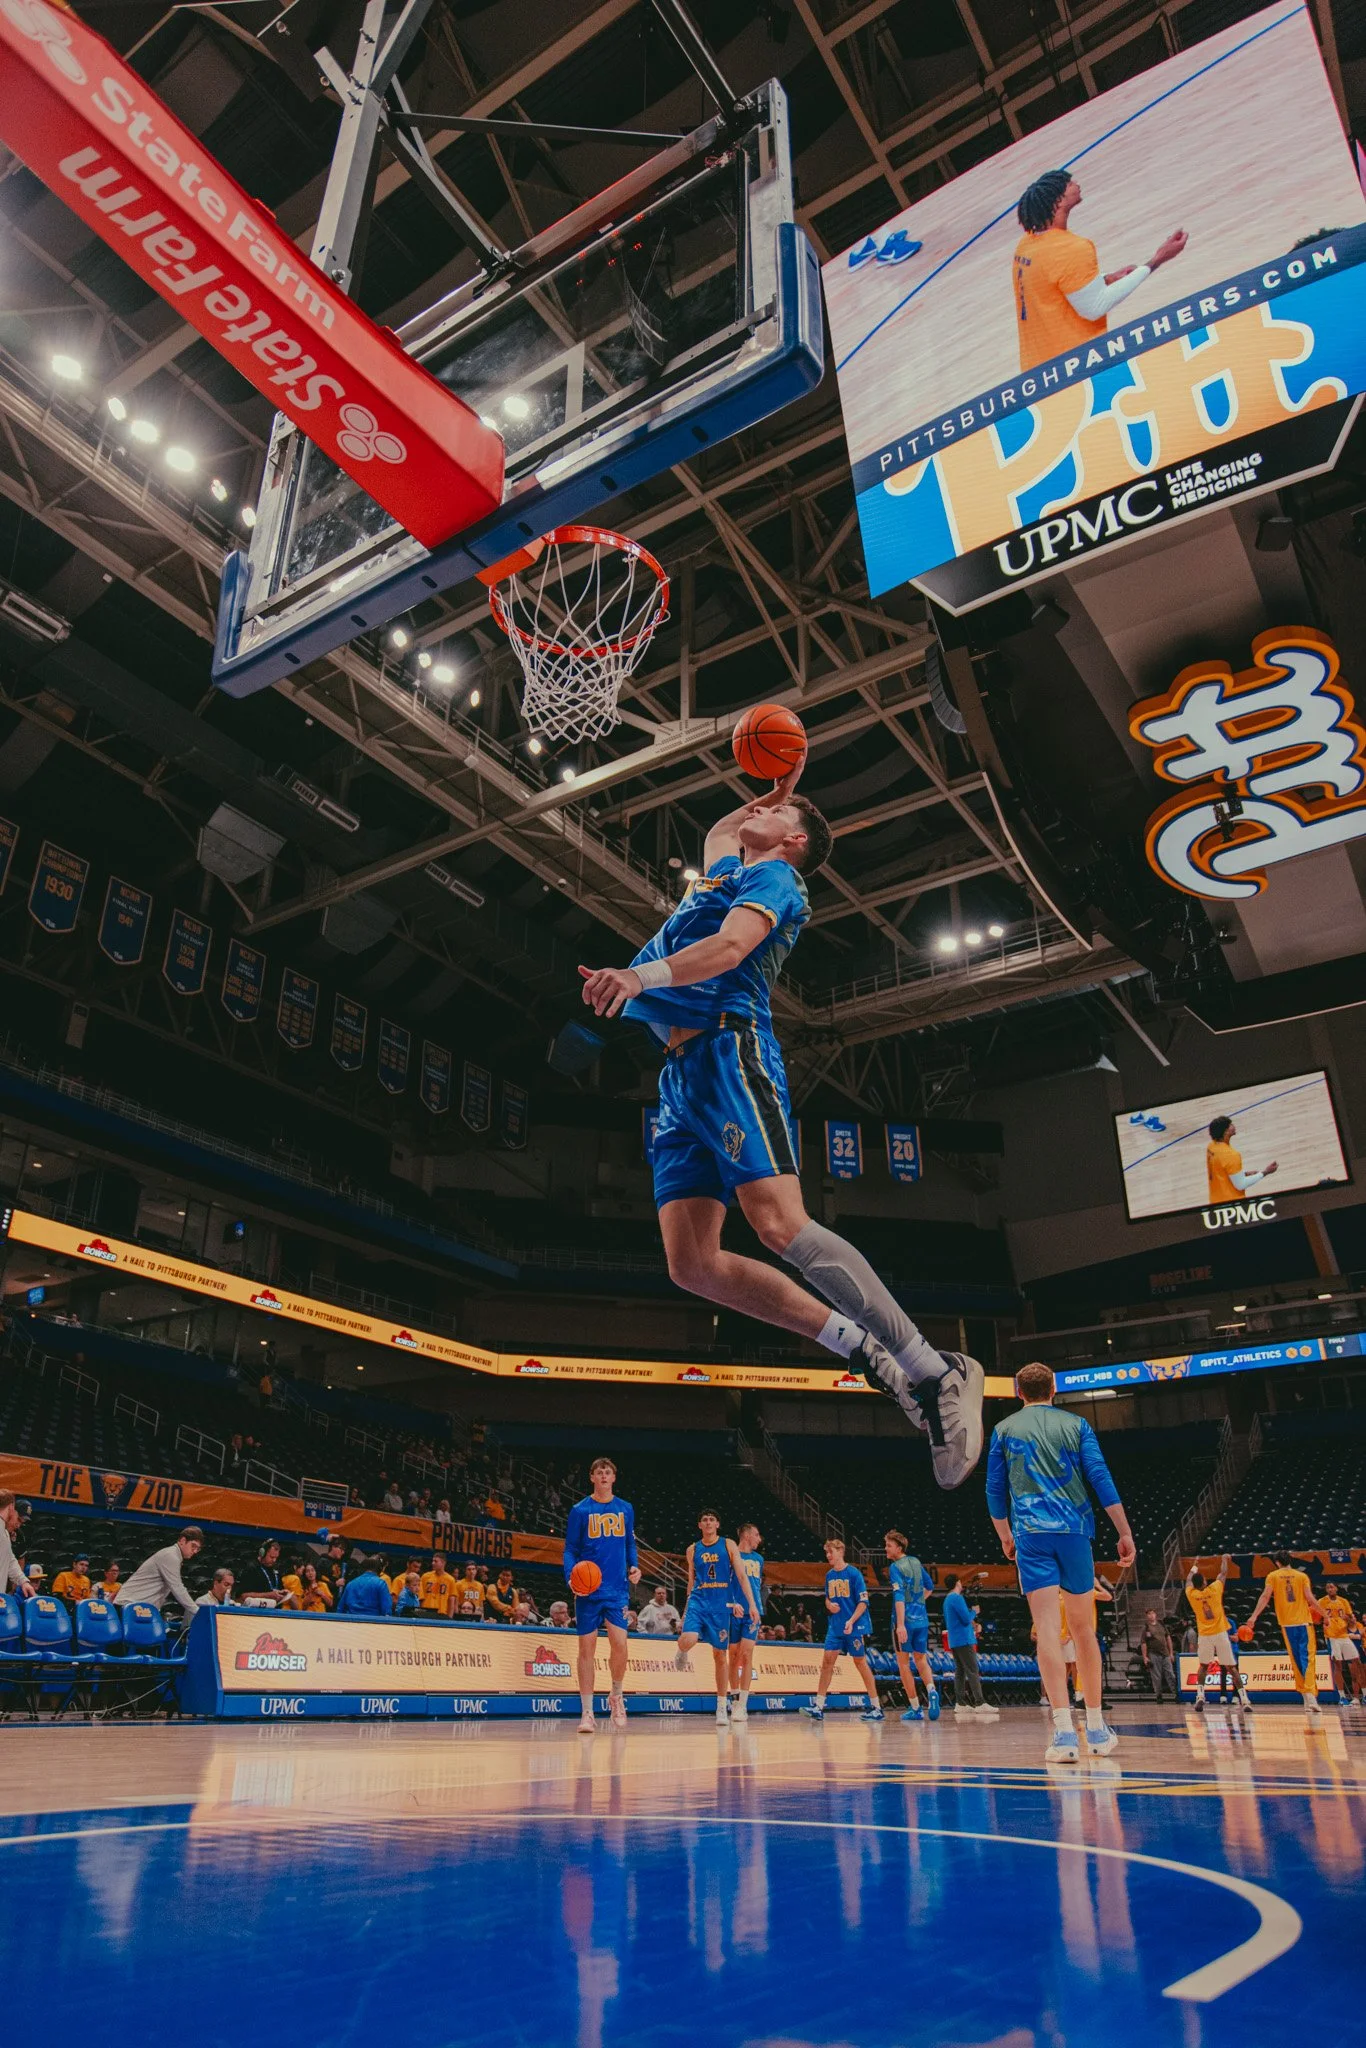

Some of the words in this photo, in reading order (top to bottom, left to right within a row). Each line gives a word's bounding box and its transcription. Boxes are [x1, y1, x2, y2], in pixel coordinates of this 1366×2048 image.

[880, 246, 1338, 473] PITTSBURGHPANTHERS.COM
[1165, 461, 1203, 486] LIFE
[1169, 452, 1262, 497] CHANGING
[1171, 468, 1257, 510] MEDICINE
[993, 479, 1163, 577] UPMC
[45, 874, 73, 901] 1930
[833, 1137, 855, 1157] 32
[893, 1140, 915, 1160] 20
[1201, 1199, 1278, 1230] UPMC
[83, 1246, 117, 1262] BOWSER
[122, 1255, 129, 1263] A
[130, 1257, 145, 1268] HAIL
[147, 1261, 156, 1271] TO
[157, 1263, 197, 1282] PITTSBURGH
[198, 1273, 228, 1292] PARTNER!
[255, 1296, 283, 1310] BOWSER
[292, 1304, 305, 1313] HAIL
[306, 1307, 314, 1316] TO
[314, 1309, 347, 1326] PITTSBURGH
[348, 1318, 372, 1334] PARTNER!
[437, 1345, 444, 1354] TO
[520, 1365, 549, 1374] BOWSER
[561, 1366, 575, 1374] HAIL
[585, 1367, 623, 1376] PITTSBURGH
[624, 1369, 653, 1378] PARTNER!
[682, 1373, 711, 1382] BOWSER
[721, 1374, 734, 1382] HAIL
[744, 1375, 781, 1384] PITTSBURGH
[781, 1376, 810, 1384] PARTNER!
[837, 1380, 865, 1388] BOWSER
[40, 1463, 83, 1500] THE
[141, 1478, 183, 1513] ZOO
[432, 1521, 513, 1559] PANTHERS
[701, 1552, 719, 1563] Pitt
[708, 1564, 716, 1580] 4
[247, 1653, 307, 1671] BOWSER
[316, 1648, 324, 1663] A
[328, 1648, 354, 1664] HAIL
[358, 1650, 372, 1665] TO
[376, 1650, 442, 1667] PITTSBURGH
[445, 1652, 492, 1668] PARTNER!
[532, 1662, 571, 1677] BOWSER
[760, 1664, 764, 1674] A
[1272, 1663, 1277, 1671] A
[260, 1698, 306, 1715] UPMC
[361, 1698, 400, 1714] UPMC
[454, 1699, 488, 1714] UPMC
[532, 1698, 562, 1713] UPMC
[659, 1698, 684, 1712] UPMC
[765, 1698, 786, 1709] UPMC
[848, 1695, 865, 1707] UPMC
